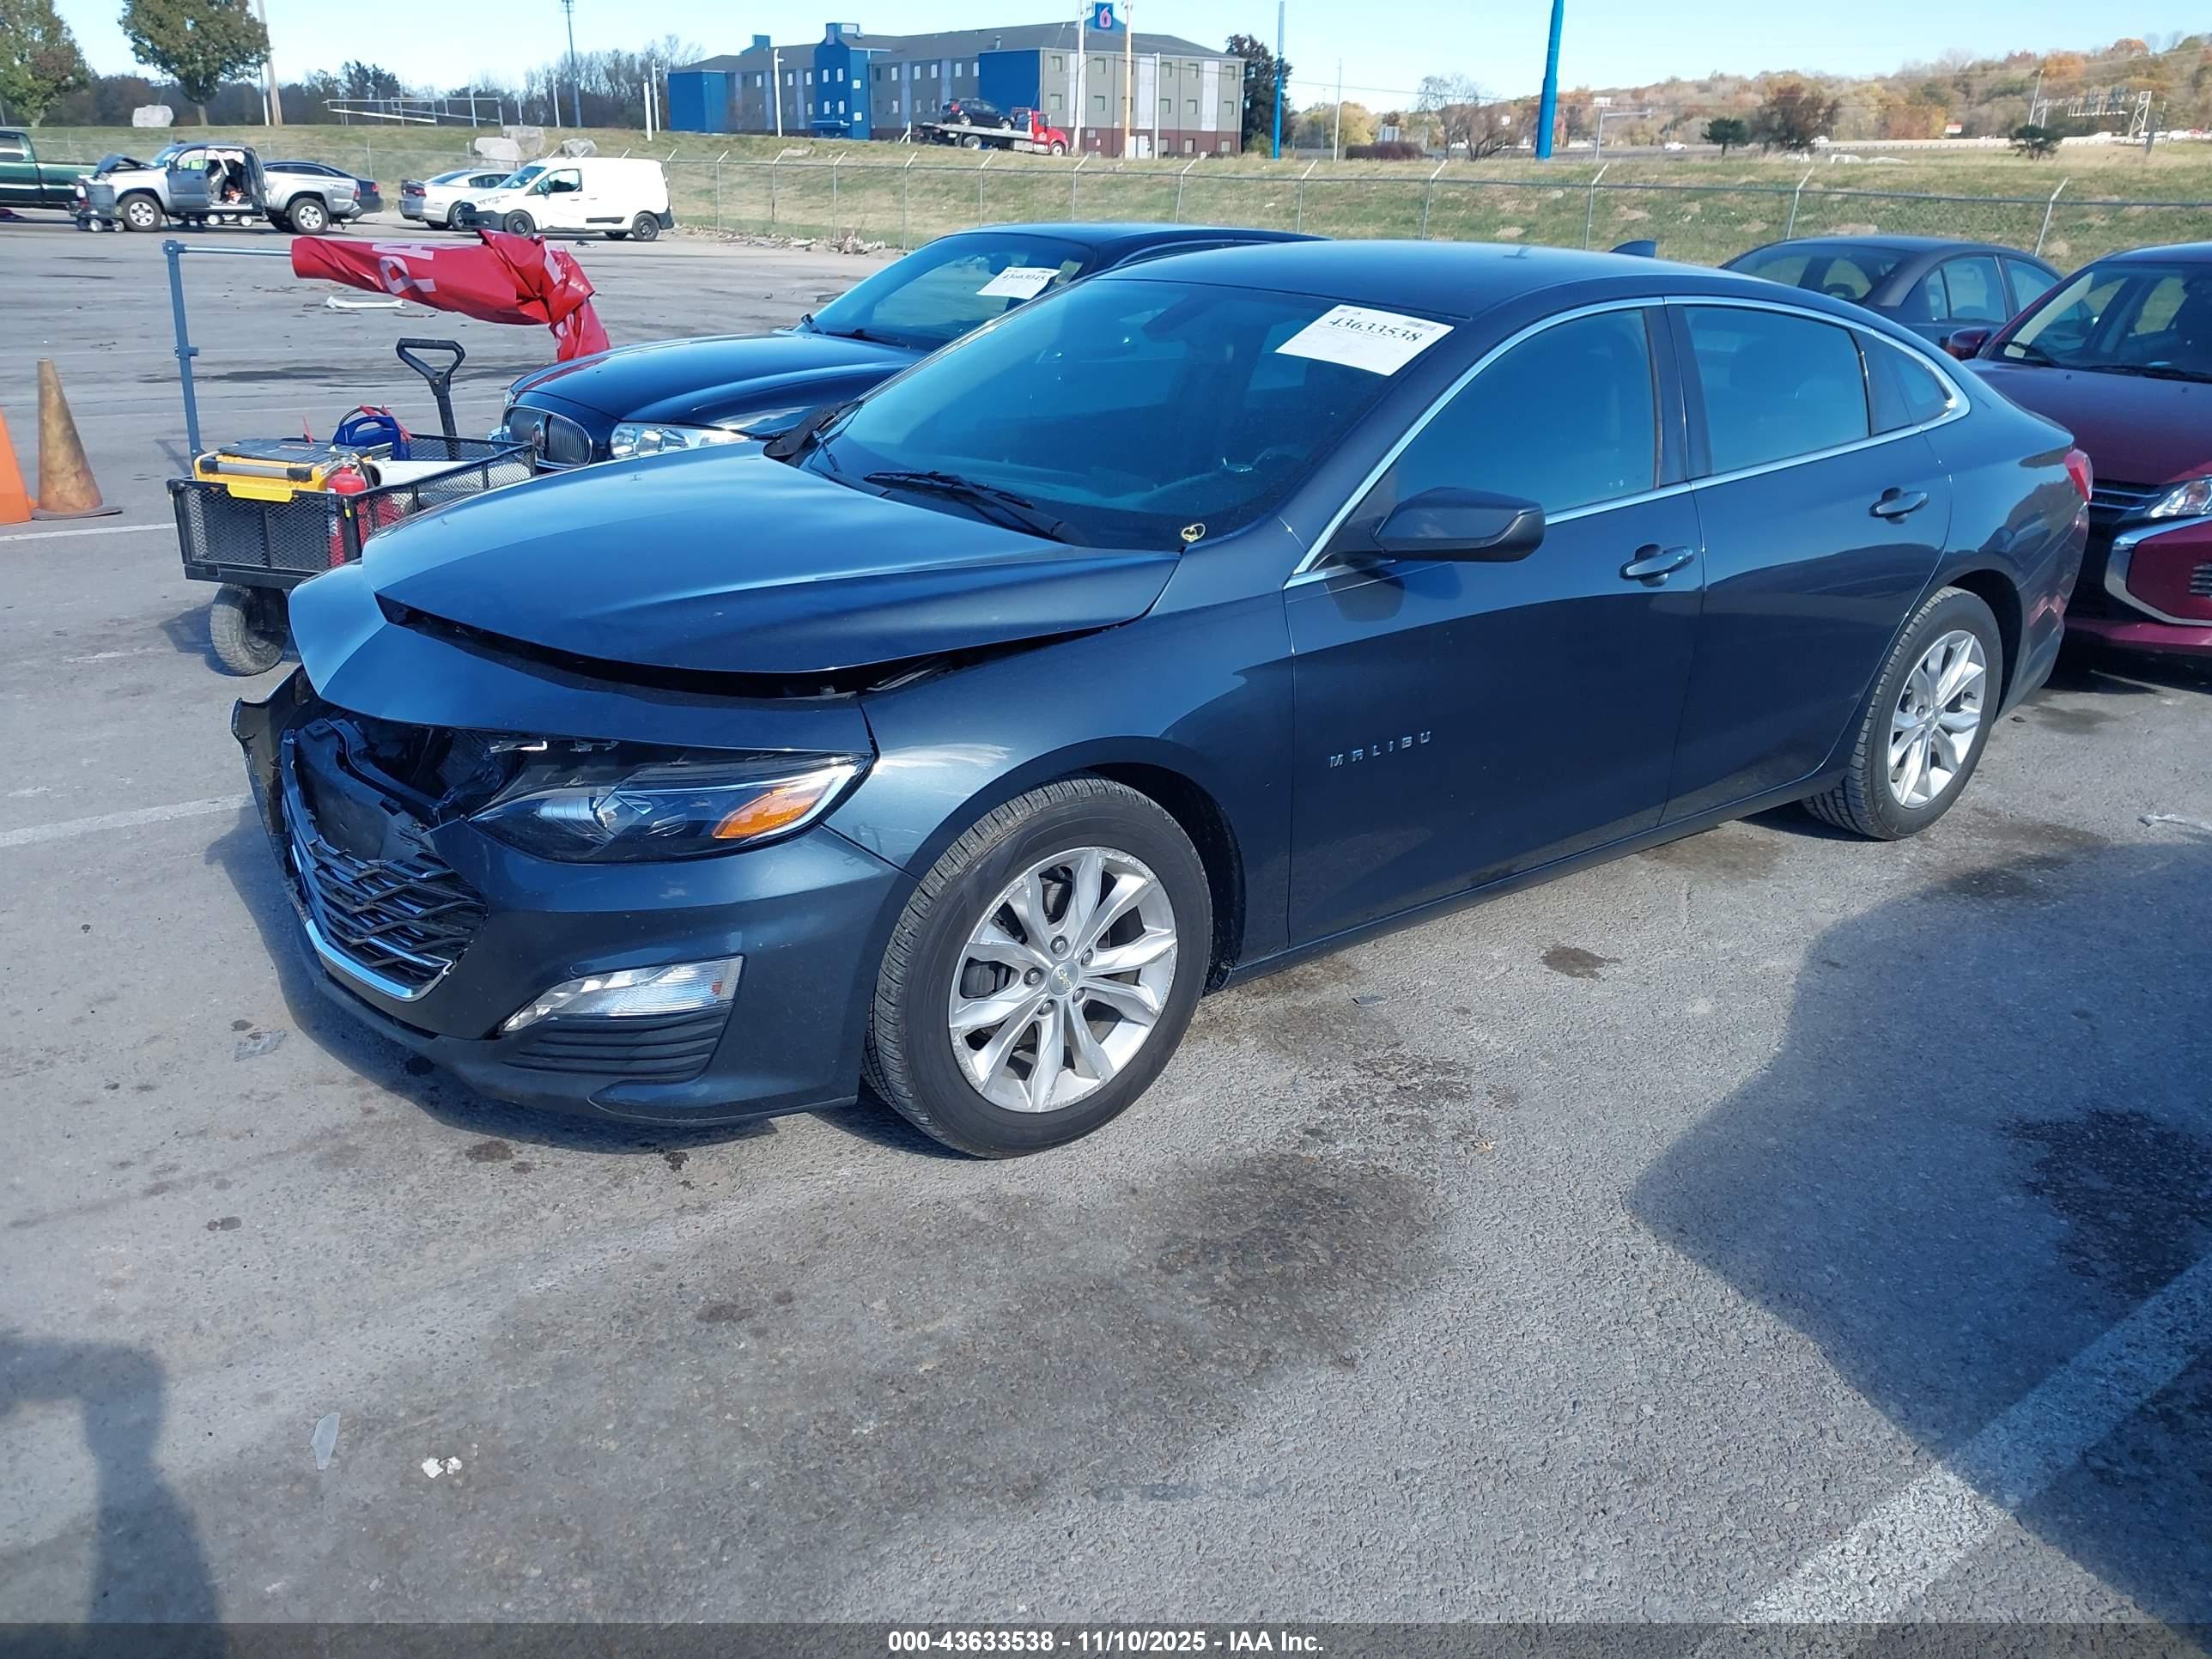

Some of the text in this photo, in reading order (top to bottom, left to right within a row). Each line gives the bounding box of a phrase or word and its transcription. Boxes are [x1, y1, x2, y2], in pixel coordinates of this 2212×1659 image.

[1099, 6, 1112, 28] 6
[1328, 317, 1423, 342] 43633538
[1330, 731, 1431, 768] MALIBU
